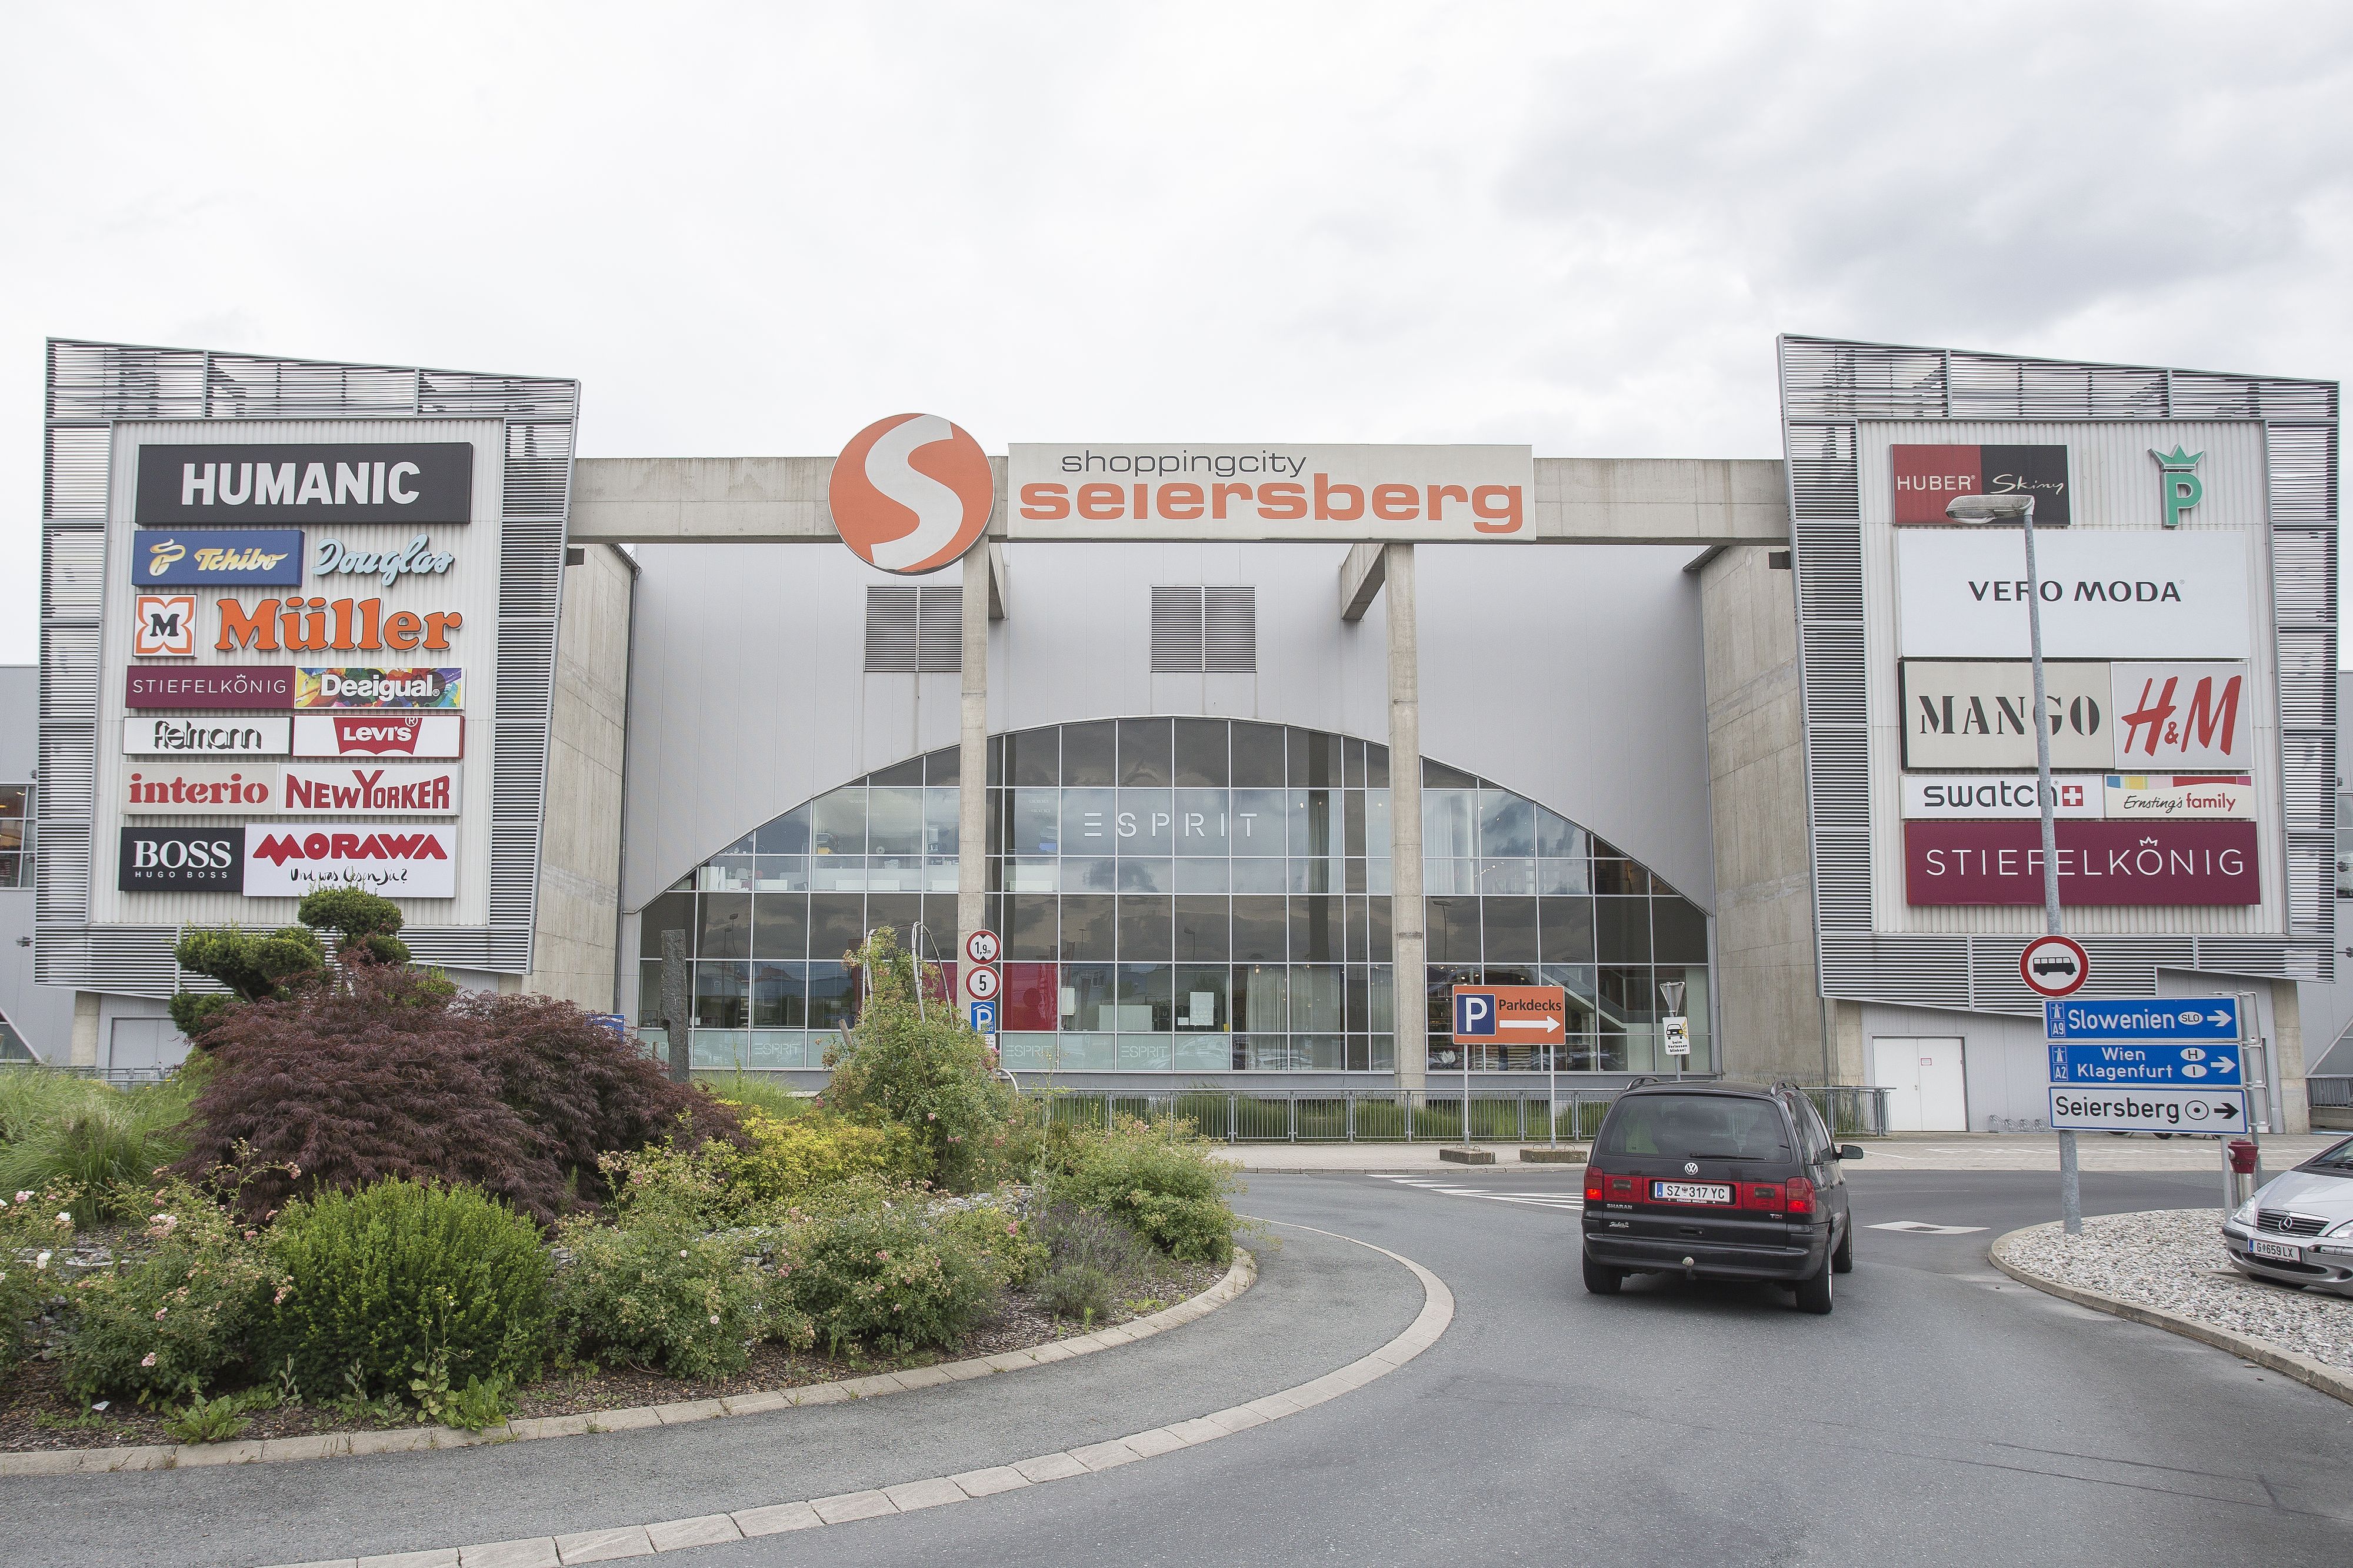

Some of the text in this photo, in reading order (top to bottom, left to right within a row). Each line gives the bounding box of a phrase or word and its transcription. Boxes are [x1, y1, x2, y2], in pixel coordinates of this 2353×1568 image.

[1061, 449, 1307, 478] shoppingcity
[181, 461, 421, 505] HUMANIC
[1897, 475, 1971, 491] HUBER
[1989, 473, 2064, 495] Skiny
[1019, 472, 1524, 534] seiersberg
[194, 548, 289, 571] Tchibo
[311, 533, 455, 587] Douglas
[2074, 580, 2182, 602] MODA
[149, 613, 181, 638] M
[214, 596, 464, 651] Müller
[132, 673, 286, 694] STIEFELKÖNIG
[321, 674, 433, 702] Desigual
[1918, 695, 2100, 737] MANGO
[2121, 675, 2242, 757] H&M
[153, 719, 262, 750] fielmann
[129, 772, 269, 805] interio
[2123, 792, 2236, 814] Ernsting's family
[1084, 811, 1258, 838] ESPRIT
[132, 840, 232, 869] BOSS
[252, 833, 448, 868] MORAWA
[1925, 835, 2244, 876] STIEFELKÖNIG
[290, 868, 315, 882] Und
[318, 870, 339, 882] was
[979, 975, 986, 992] 5
[1465, 997, 1488, 1032] P
[1498, 999, 1562, 1012] Parkdecks
[976, 1008, 992, 1033] P
[2052, 1022, 2064, 1036] A9
[2068, 1008, 2199, 1029] Slowenien SLO
[755, 1043, 800, 1055] ESPRIT
[1121, 1045, 1168, 1058] ESPRIT
[2101, 1046, 2199, 1061] Wien H
[2055, 1066, 2067, 1079] A2
[2077, 1063, 2173, 1081] Klagenfurt
[2055, 1095, 2179, 1125] Seiersberg
[1667, 1185, 1681, 1197] SZ
[1689, 1186, 1708, 1198] 317
[1711, 1187, 1725, 1199] YC
[2266, 1244, 2281, 1256] 659
[2282, 1246, 2294, 1258] LX
